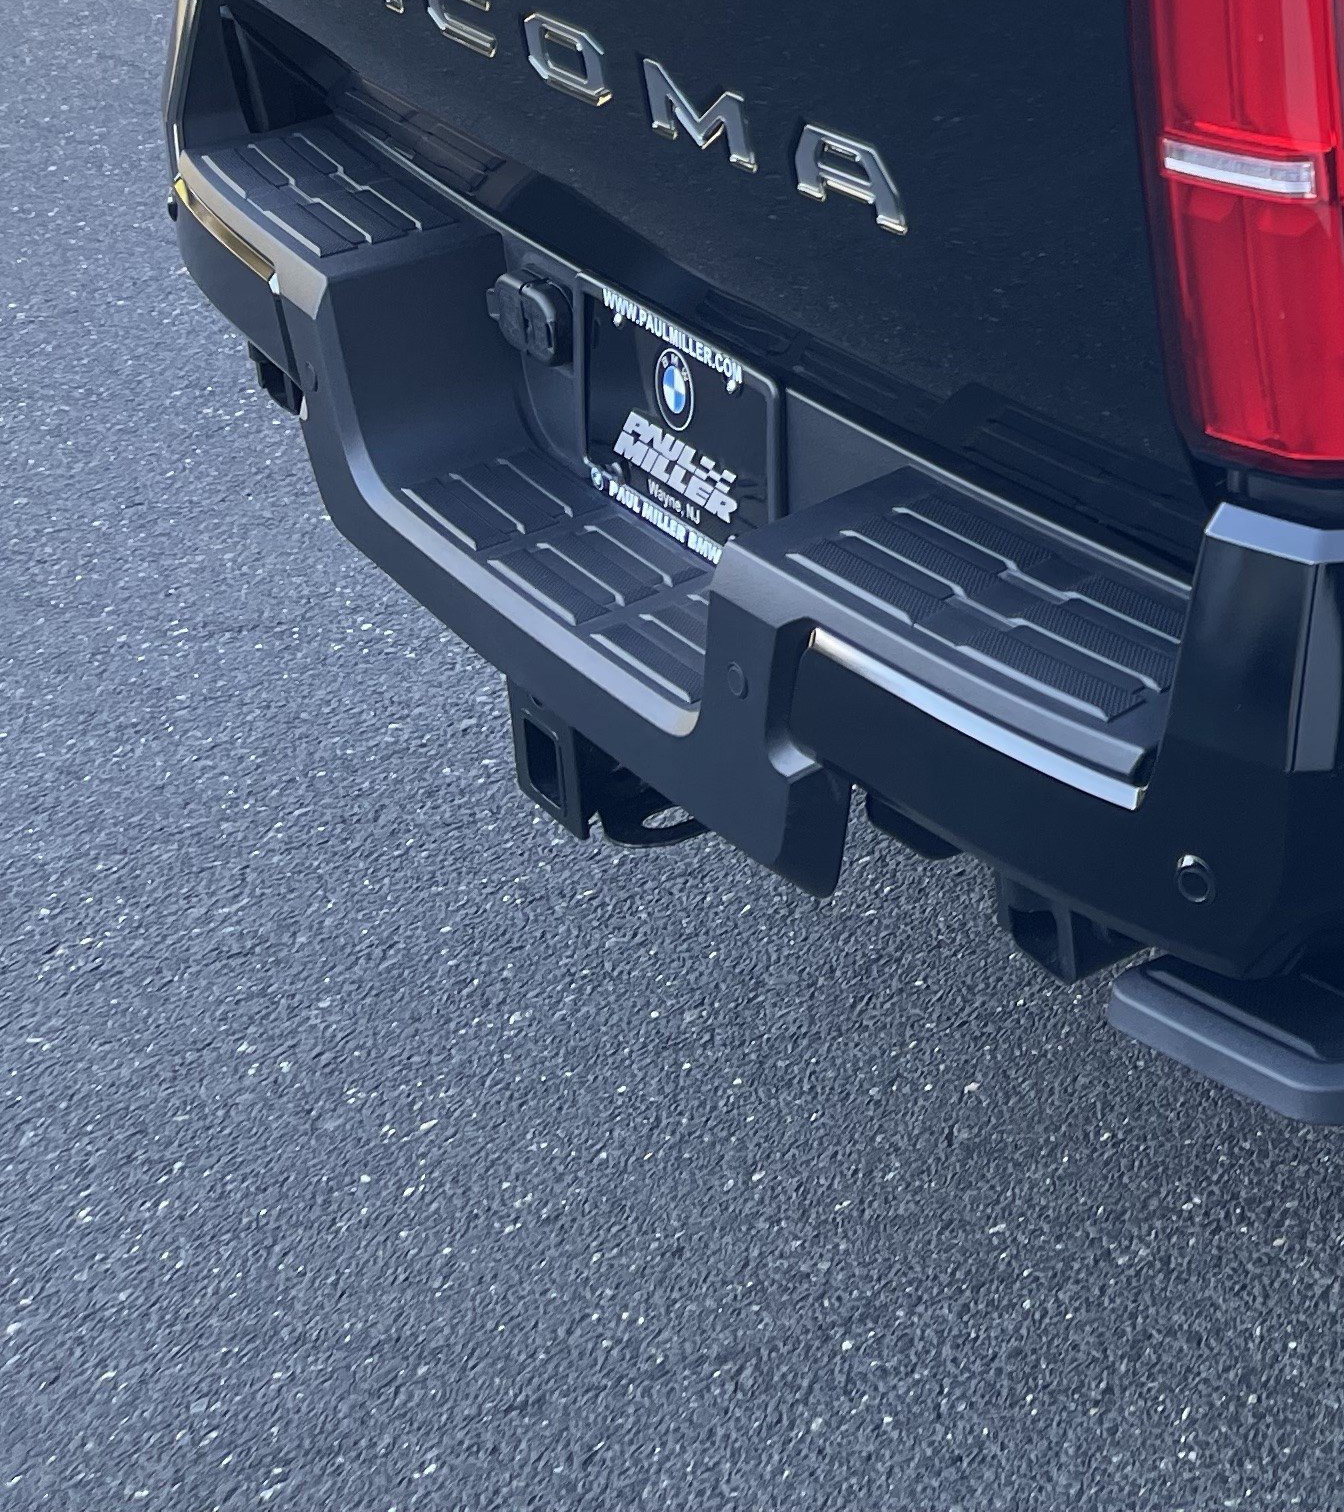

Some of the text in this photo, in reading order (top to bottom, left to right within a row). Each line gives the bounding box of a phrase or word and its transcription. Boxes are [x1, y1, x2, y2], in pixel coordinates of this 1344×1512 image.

[602, 288, 743, 384] WWW.PAULMILLER.COM
[613, 431, 738, 524] MILLER
[622, 411, 697, 473] PAUL
[608, 480, 723, 565] PAUL MILLER BMW
[648, 478, 701, 525] Wayne, NJ
